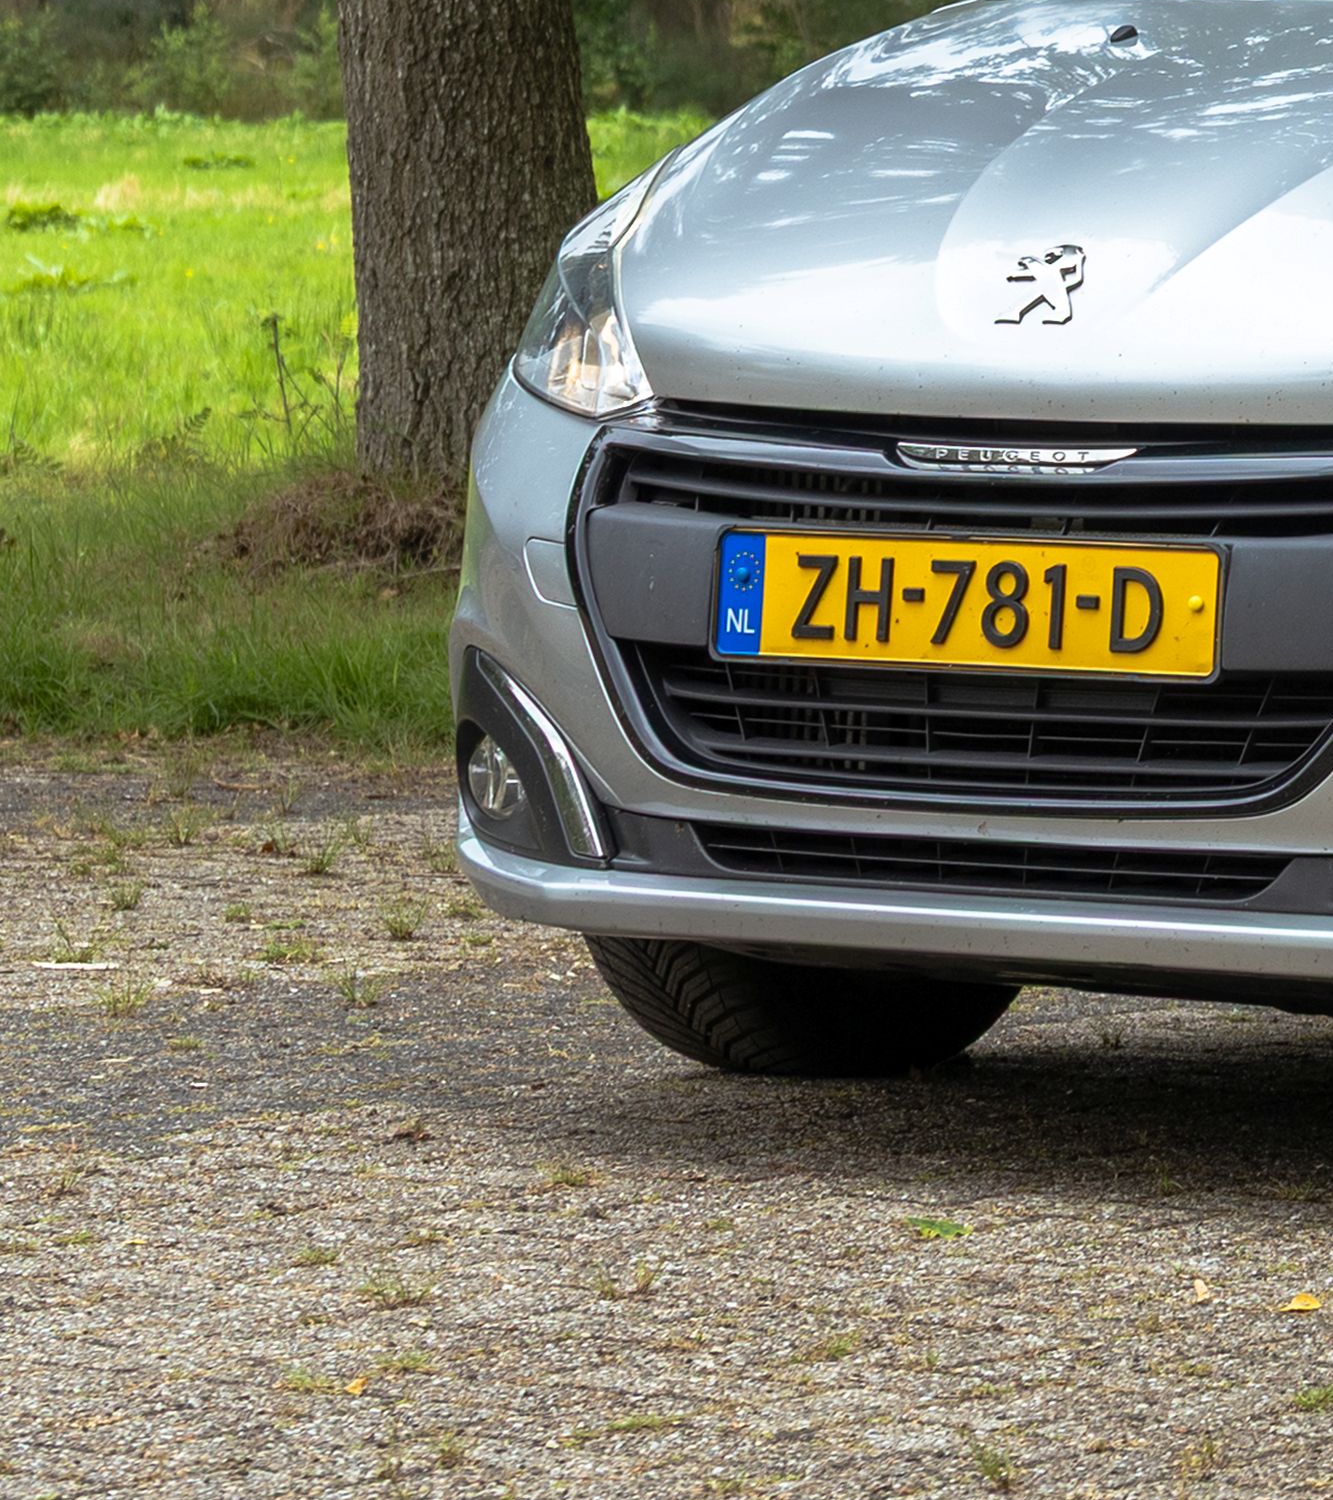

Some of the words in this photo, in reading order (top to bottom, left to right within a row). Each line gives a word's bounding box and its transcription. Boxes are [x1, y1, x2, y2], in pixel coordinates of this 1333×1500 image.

[935, 448, 1090, 464] PEUGEOT
[791, 554, 1164, 654] ZH-781-D
[725, 608, 755, 635] NL
